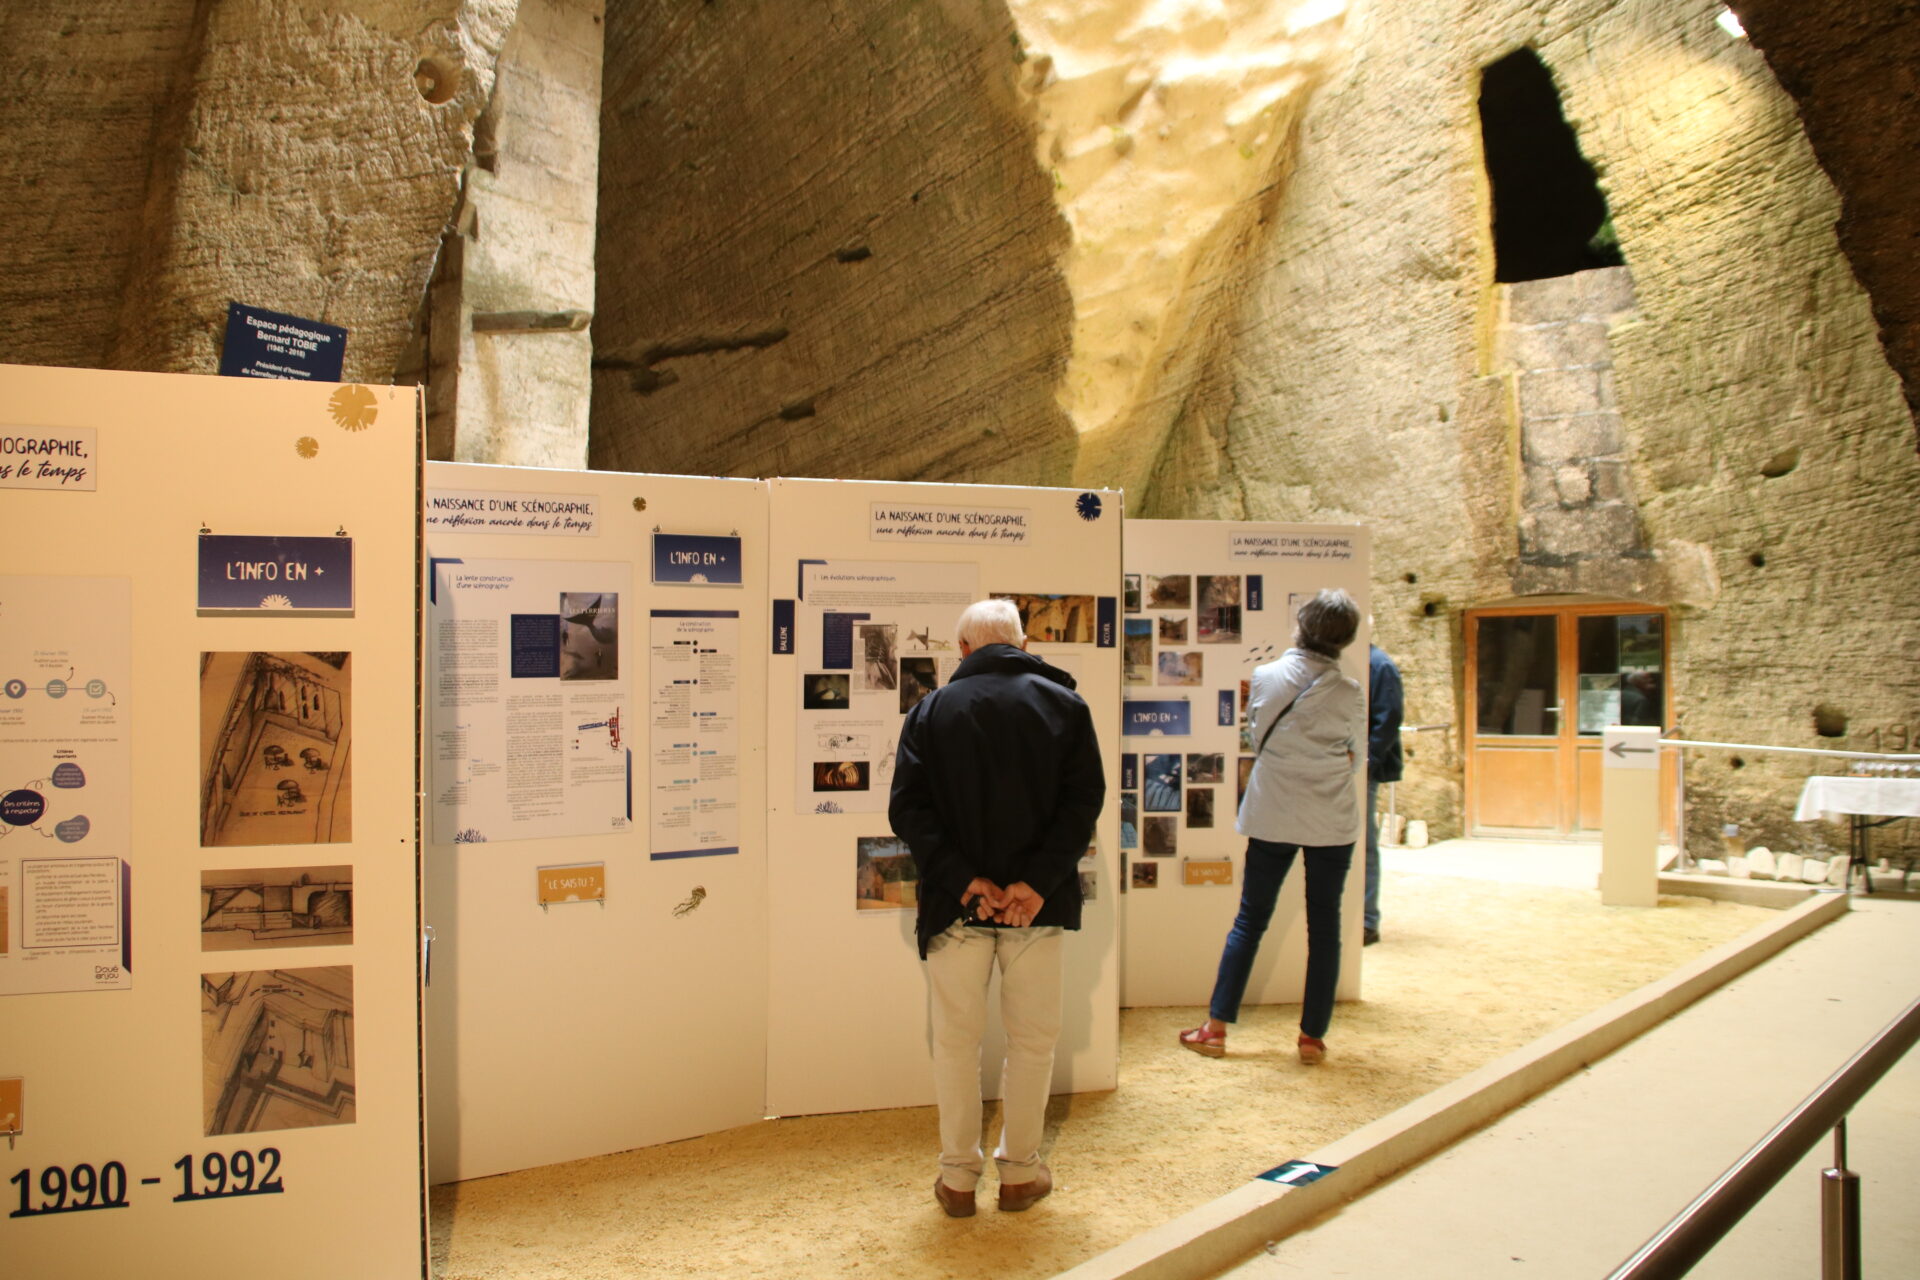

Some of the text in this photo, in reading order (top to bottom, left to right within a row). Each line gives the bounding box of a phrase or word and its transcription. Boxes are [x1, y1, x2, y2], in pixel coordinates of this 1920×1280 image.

[246, 315, 331, 342] Espace pédagogique
[257, 330, 318, 352] Bernard TOBIE
[256, 360, 283, 372] Président
[0, 437, 88, 459] OGRAPHIE,
[16, 459, 33, 478] le
[36, 460, 88, 485] temps
[433, 498, 485, 511] NAISSANCE
[489, 499, 518, 513] D'UNE
[522, 499, 594, 516] SCÉNOGRAPHIE,
[426, 513, 593, 533] ne réflexion ancrée dans le temps
[875, 510, 1027, 527] LA NAISSANCE D'UNE SCÉNOGRAPHIE,
[896, 523, 933, 537] réflexion
[936, 527, 965, 537] ancrée
[968, 527, 989, 539] dans
[991, 527, 998, 538] le
[1000, 527, 1025, 543] temps
[1233, 538, 1242, 546] LA
[1244, 537, 1279, 547] NAISSANCE
[1281, 538, 1300, 547] D'UNE
[670, 551, 700, 565] L'INFO
[703, 553, 717, 565] EN
[226, 561, 279, 581] L'INFO
[285, 562, 307, 581] EN
[780, 625, 788, 651] BALEINE
[1103, 623, 1111, 645] ACCUEIL
[1133, 712, 1158, 723] L'INFO
[1160, 712, 1171, 723] EN
[4, 799, 41, 808] Des critères
[10, 807, 40, 816] respecter
[549, 879, 558, 890] LE
[9, 1160, 129, 1217] 1990
[173, 1147, 284, 1201] 1992
